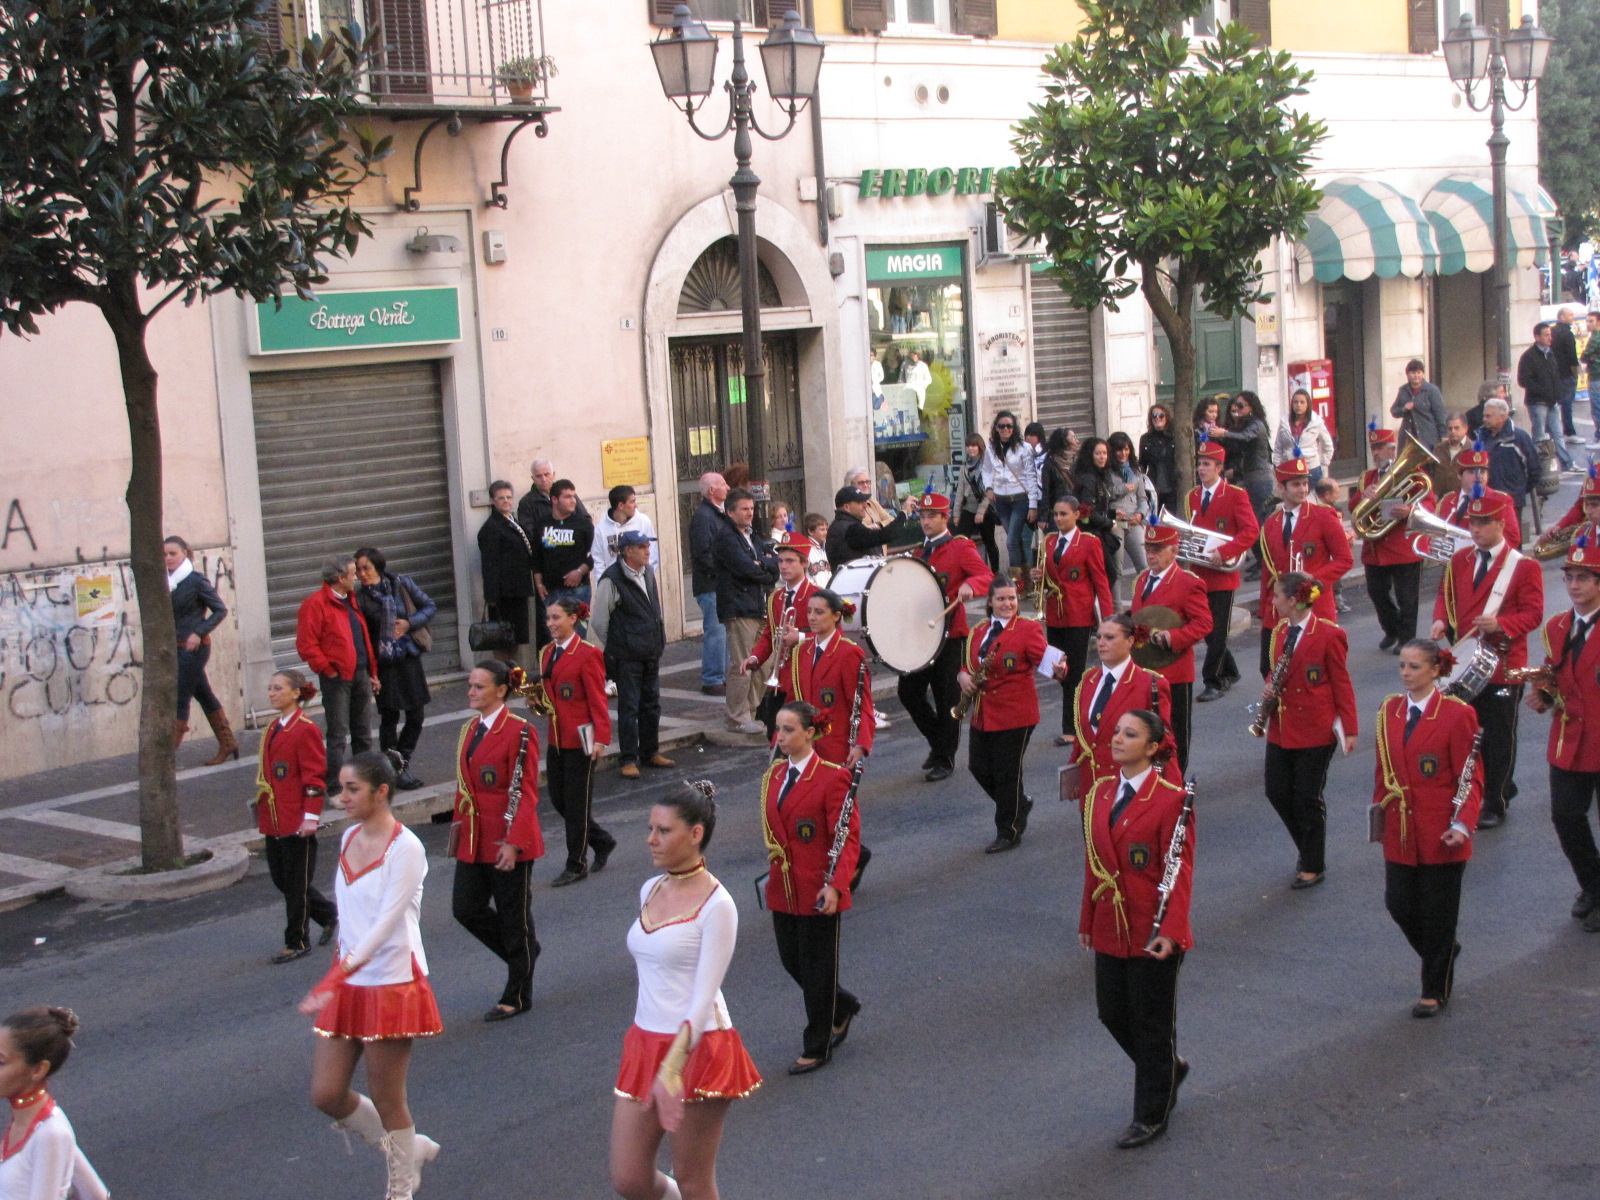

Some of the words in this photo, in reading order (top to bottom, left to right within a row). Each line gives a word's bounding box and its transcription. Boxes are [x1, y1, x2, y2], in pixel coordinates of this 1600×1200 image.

[887, 253, 943, 273] MAGIA
[310, 305, 365, 335] Bottega
[369, 301, 415, 326] Verde
[625, 319, 630, 328] 8
[495, 329, 505, 339] 10
[985, 332, 1024, 351] ERBORISTERIA
